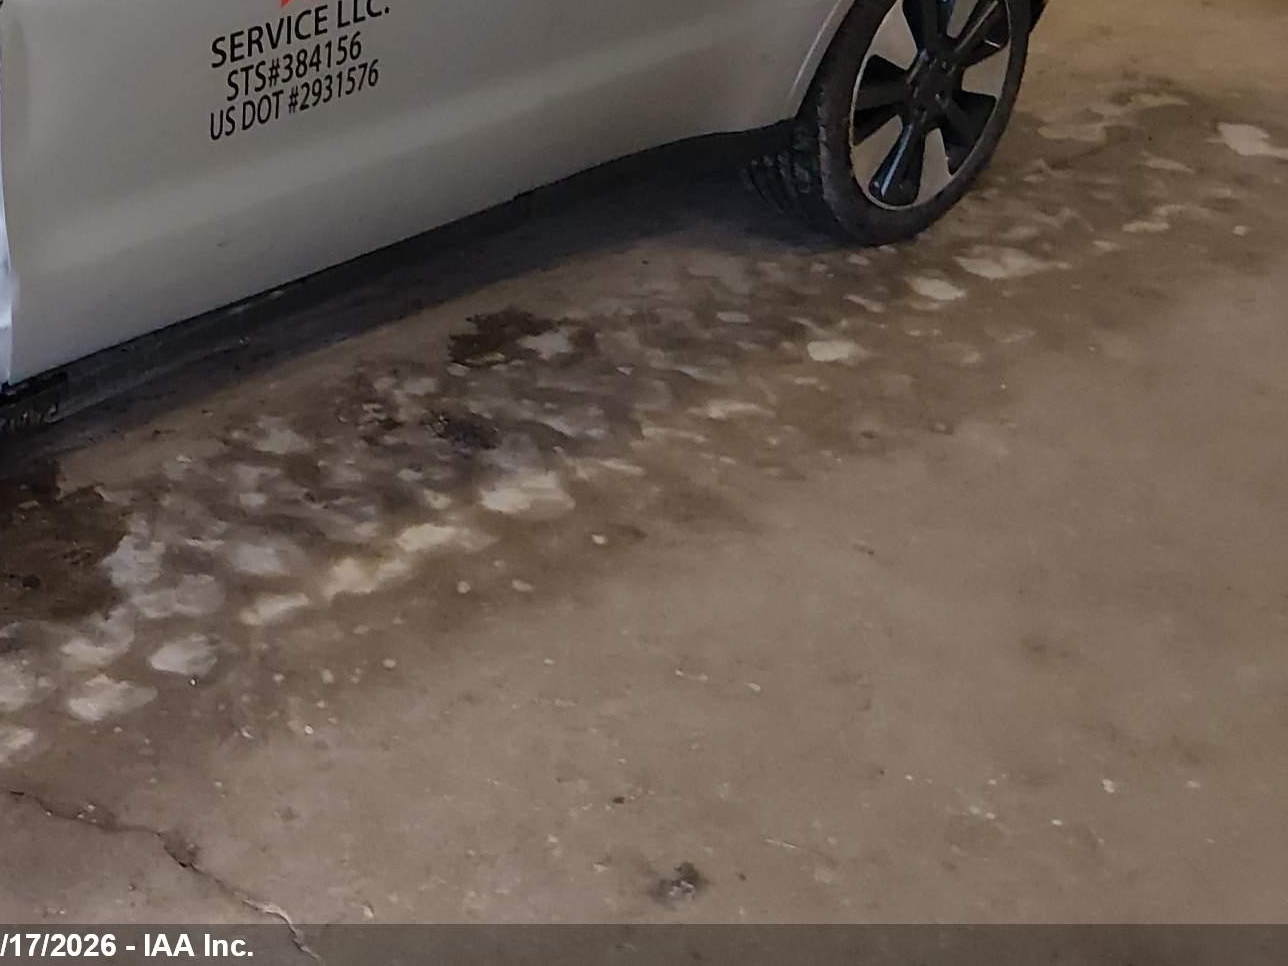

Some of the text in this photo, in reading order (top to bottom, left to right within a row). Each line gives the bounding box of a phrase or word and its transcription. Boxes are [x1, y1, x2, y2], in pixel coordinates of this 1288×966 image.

[211, 4, 328, 69] SERVICE
[226, 31, 362, 102] STS#384156
[210, 59, 379, 141] US DOT #2931576
